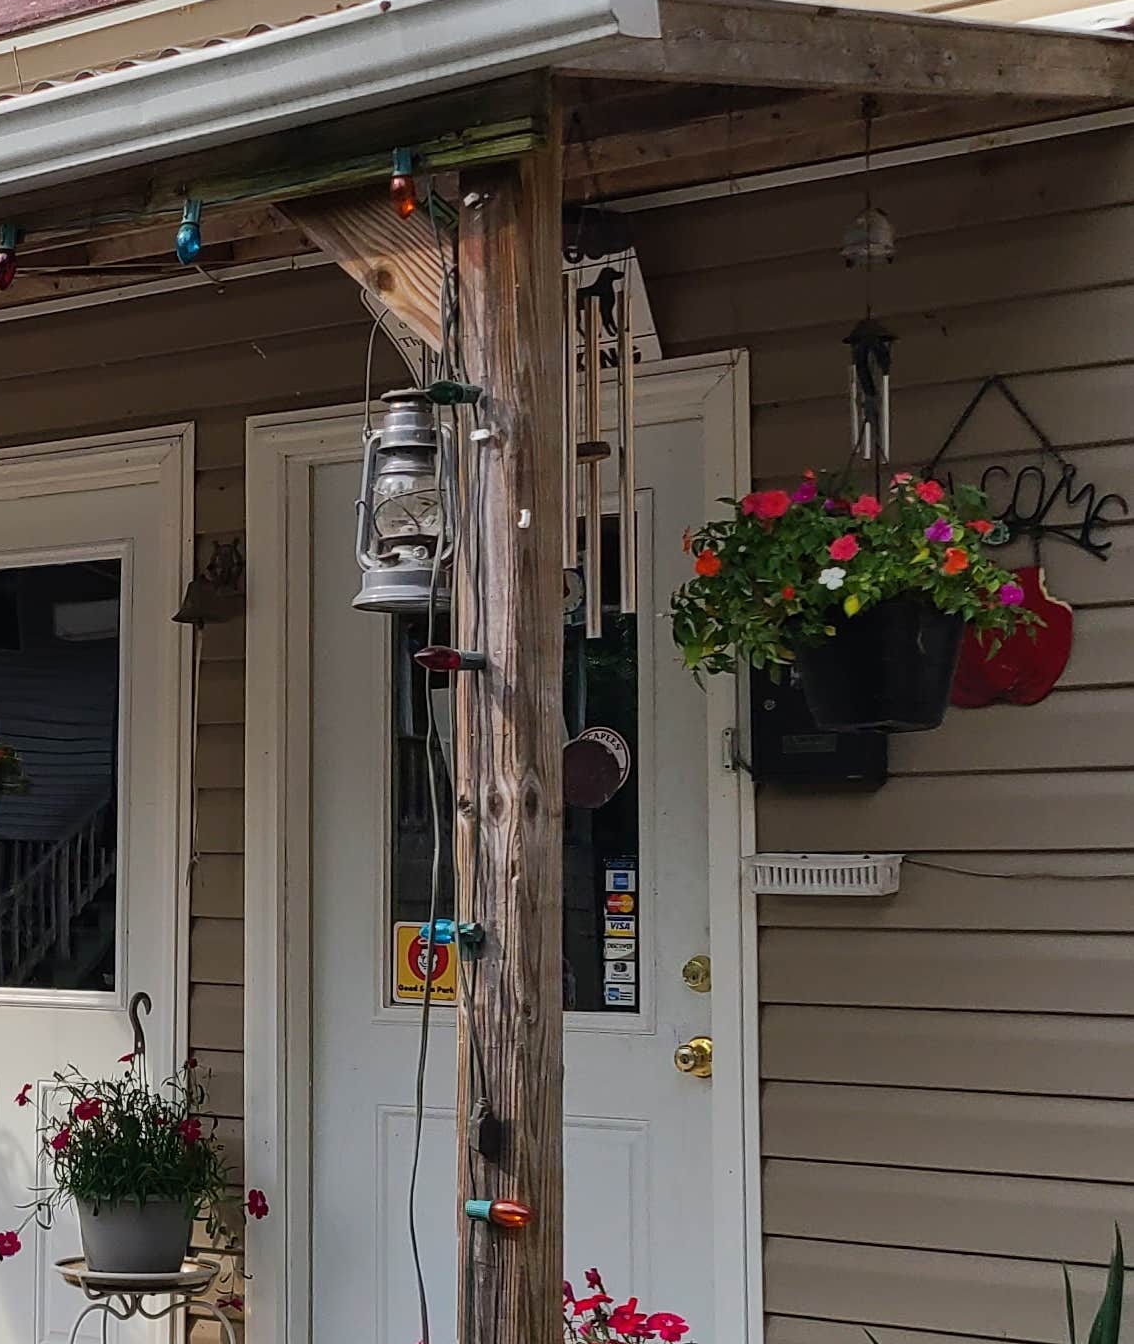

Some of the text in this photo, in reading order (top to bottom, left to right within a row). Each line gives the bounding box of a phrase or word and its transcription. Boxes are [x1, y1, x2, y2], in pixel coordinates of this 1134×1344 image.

[610, 922, 631, 930] VISA
[398, 984, 454, 994] Good Sm Park
